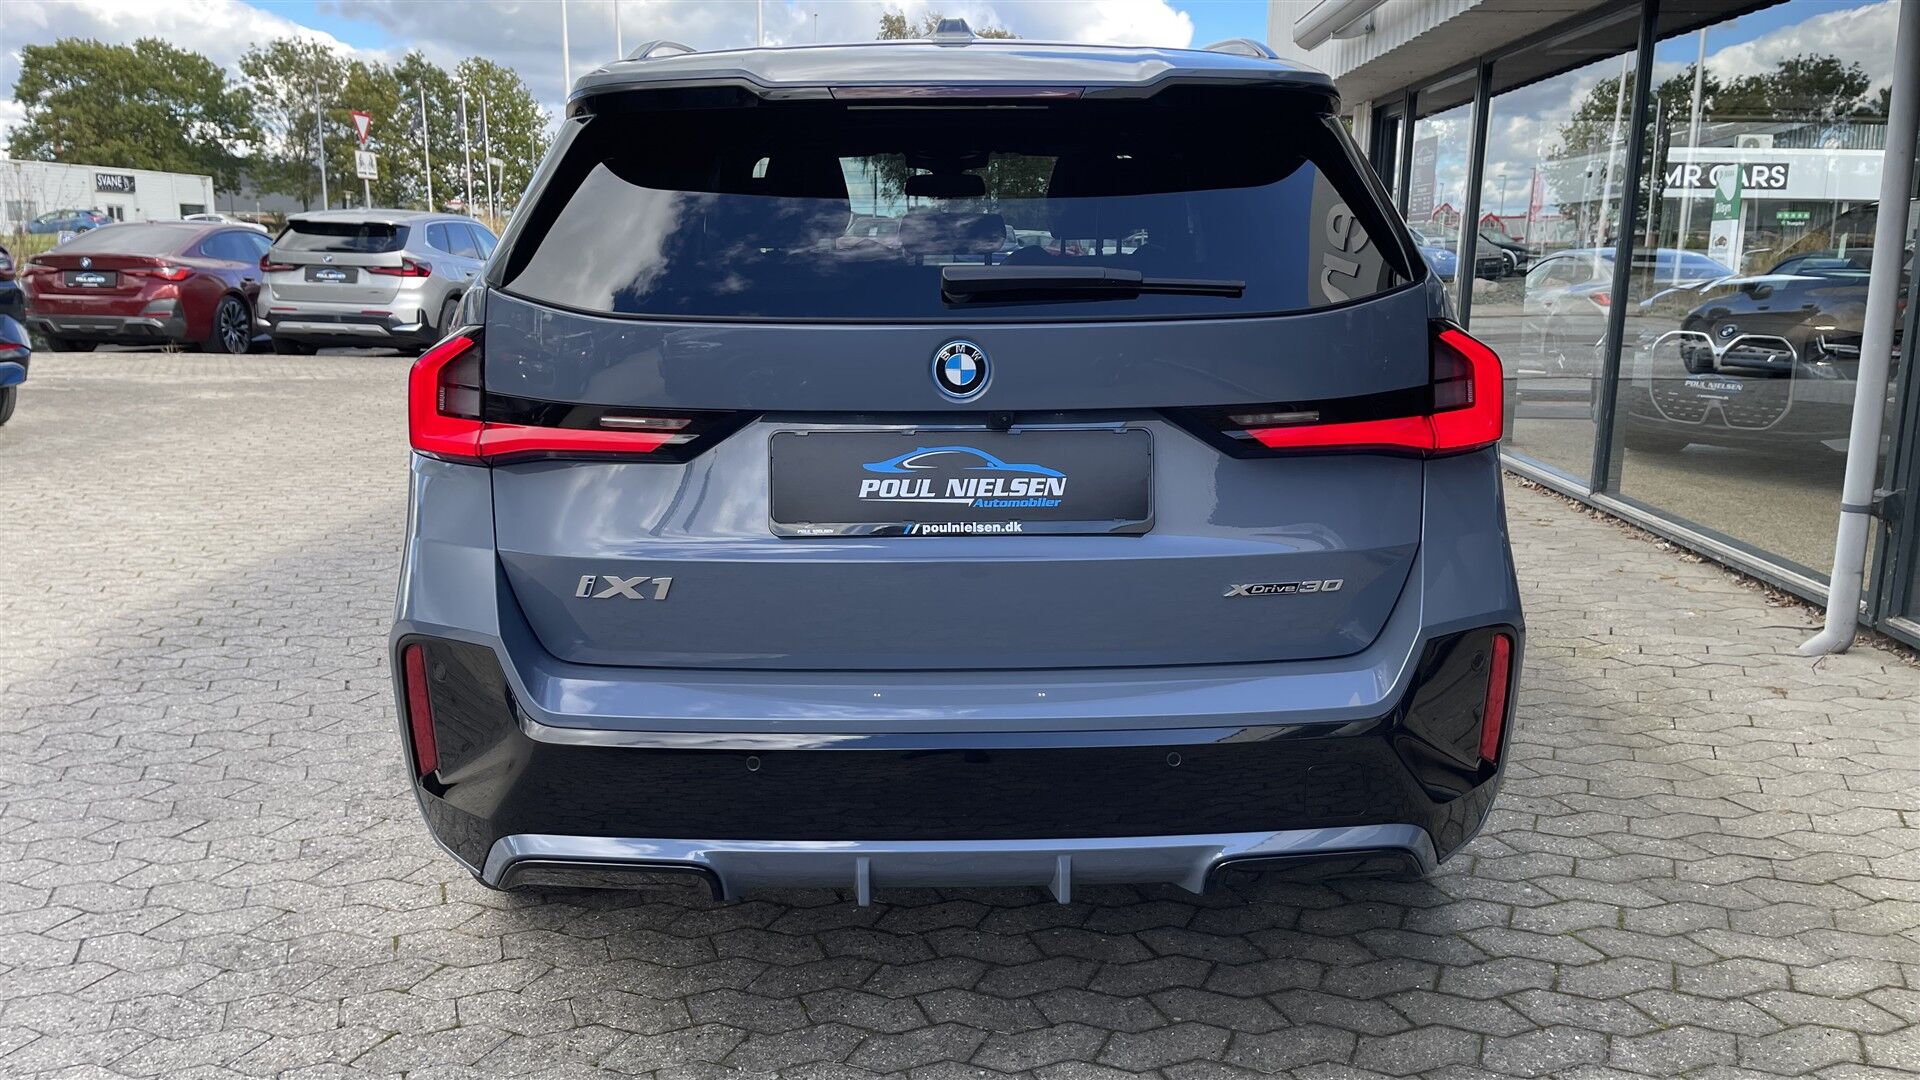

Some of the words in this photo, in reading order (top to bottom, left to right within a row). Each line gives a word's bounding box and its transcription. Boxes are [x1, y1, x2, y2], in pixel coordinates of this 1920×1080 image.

[97, 174, 123, 189] SVANE
[1664, 164, 1701, 187] MR
[940, 345, 982, 361] BMW
[859, 479, 936, 498] POUL
[945, 478, 1067, 497] NIELSEN
[973, 498, 1061, 508] Automobiler
[575, 575, 673, 600] iX1
